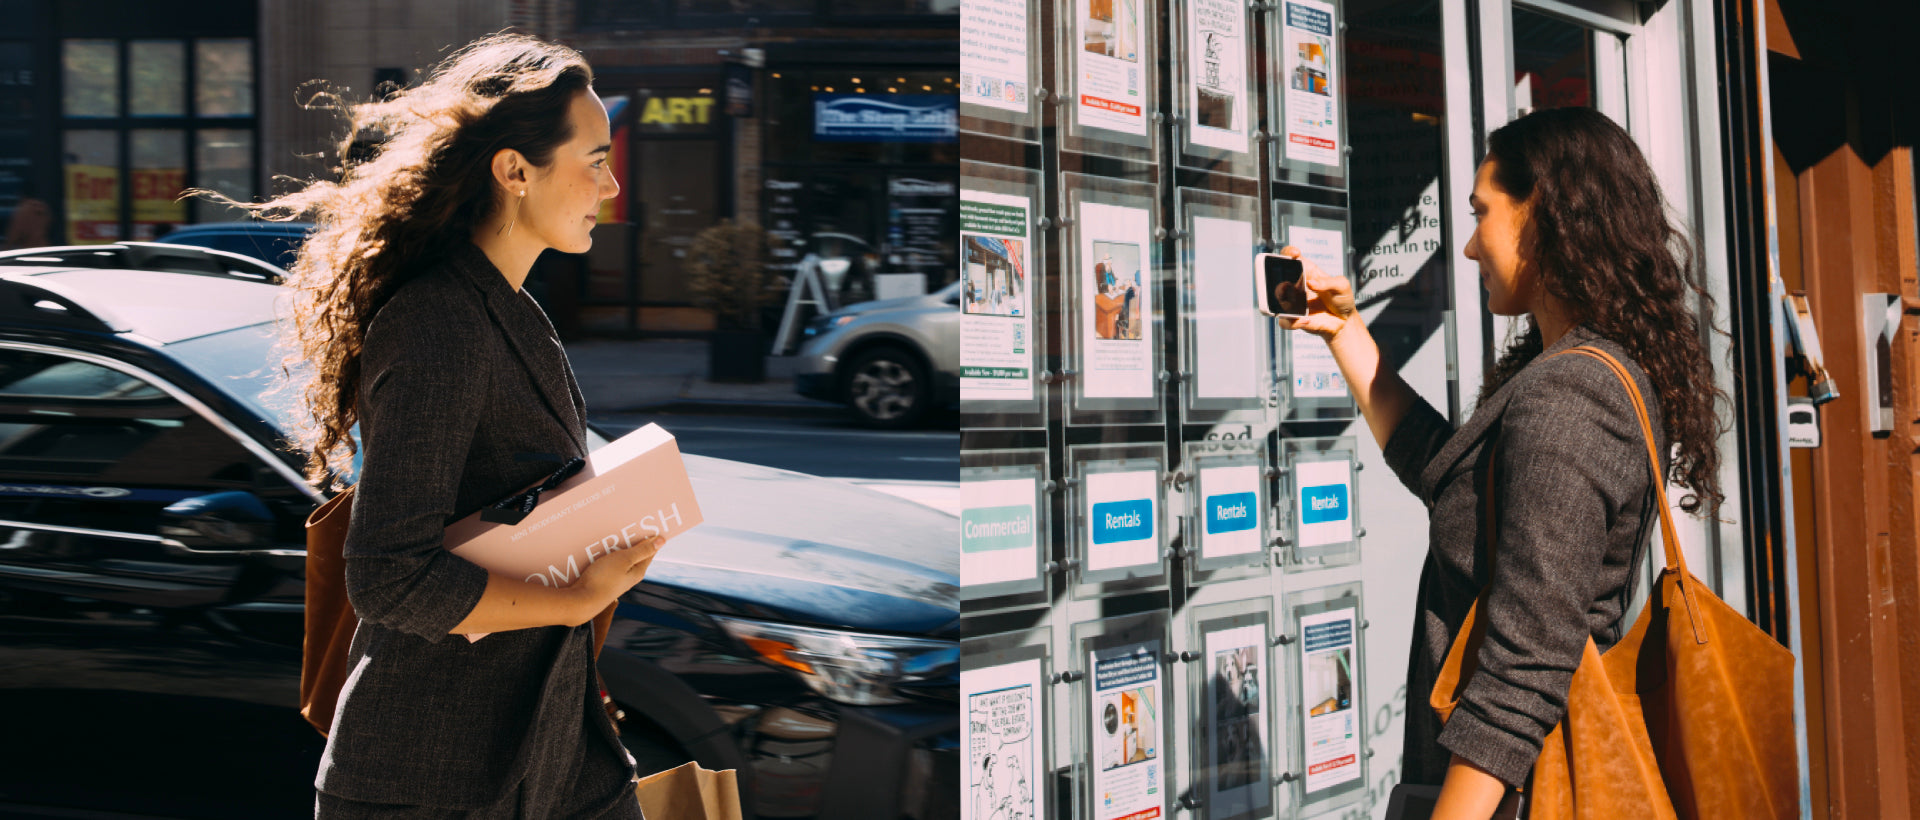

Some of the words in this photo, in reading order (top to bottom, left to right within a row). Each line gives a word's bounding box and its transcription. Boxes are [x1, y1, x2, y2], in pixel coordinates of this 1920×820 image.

[641, 97, 715, 124] ART
[1404, 240, 1418, 254] in
[1423, 238, 1440, 252] th
[1216, 501, 1247, 520] Rentals
[1311, 494, 1339, 511] Rentals
[964, 514, 1031, 538] Commercial
[1105, 508, 1141, 530] Rentals
[511, 528, 528, 542] MINI
[585, 502, 683, 563] FRESH
